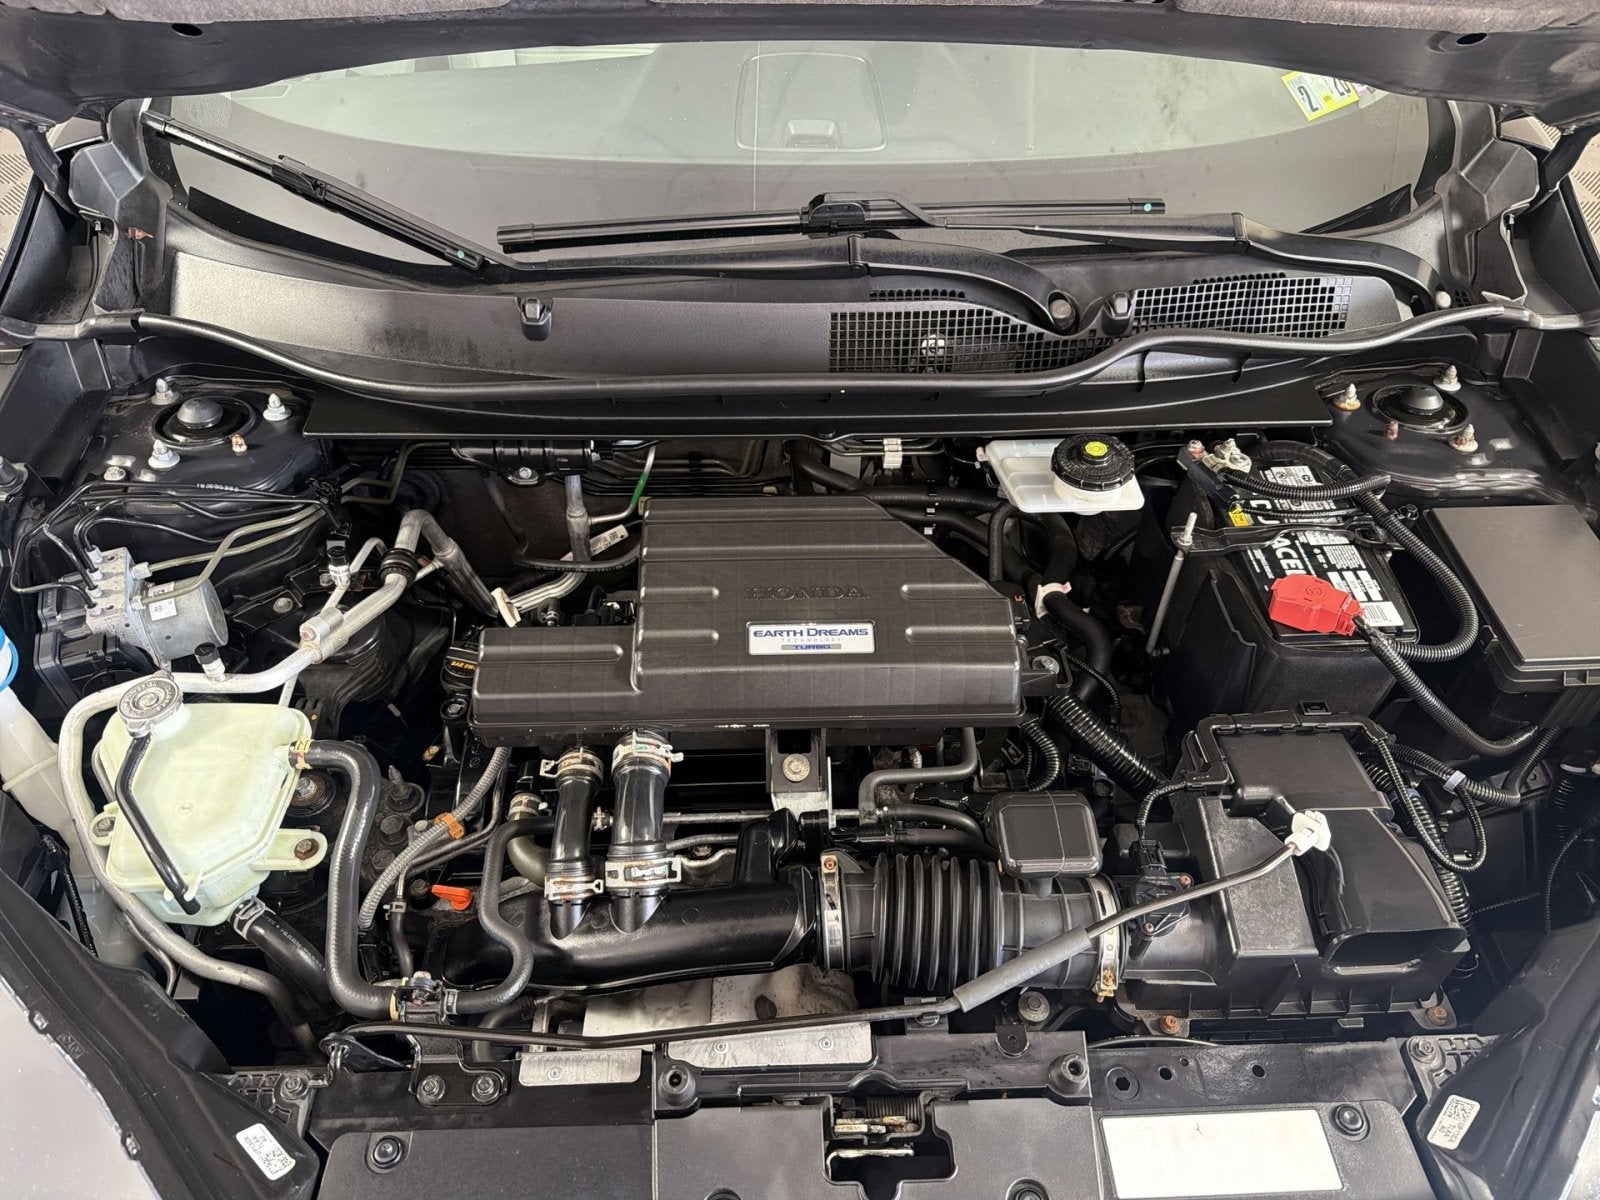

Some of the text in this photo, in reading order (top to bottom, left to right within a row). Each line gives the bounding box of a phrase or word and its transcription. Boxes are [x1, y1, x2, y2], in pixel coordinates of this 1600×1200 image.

[1297, 86, 1319, 112] 2
[745, 587, 870, 600] HONDA
[753, 628, 869, 638] EARTH DREAMS
